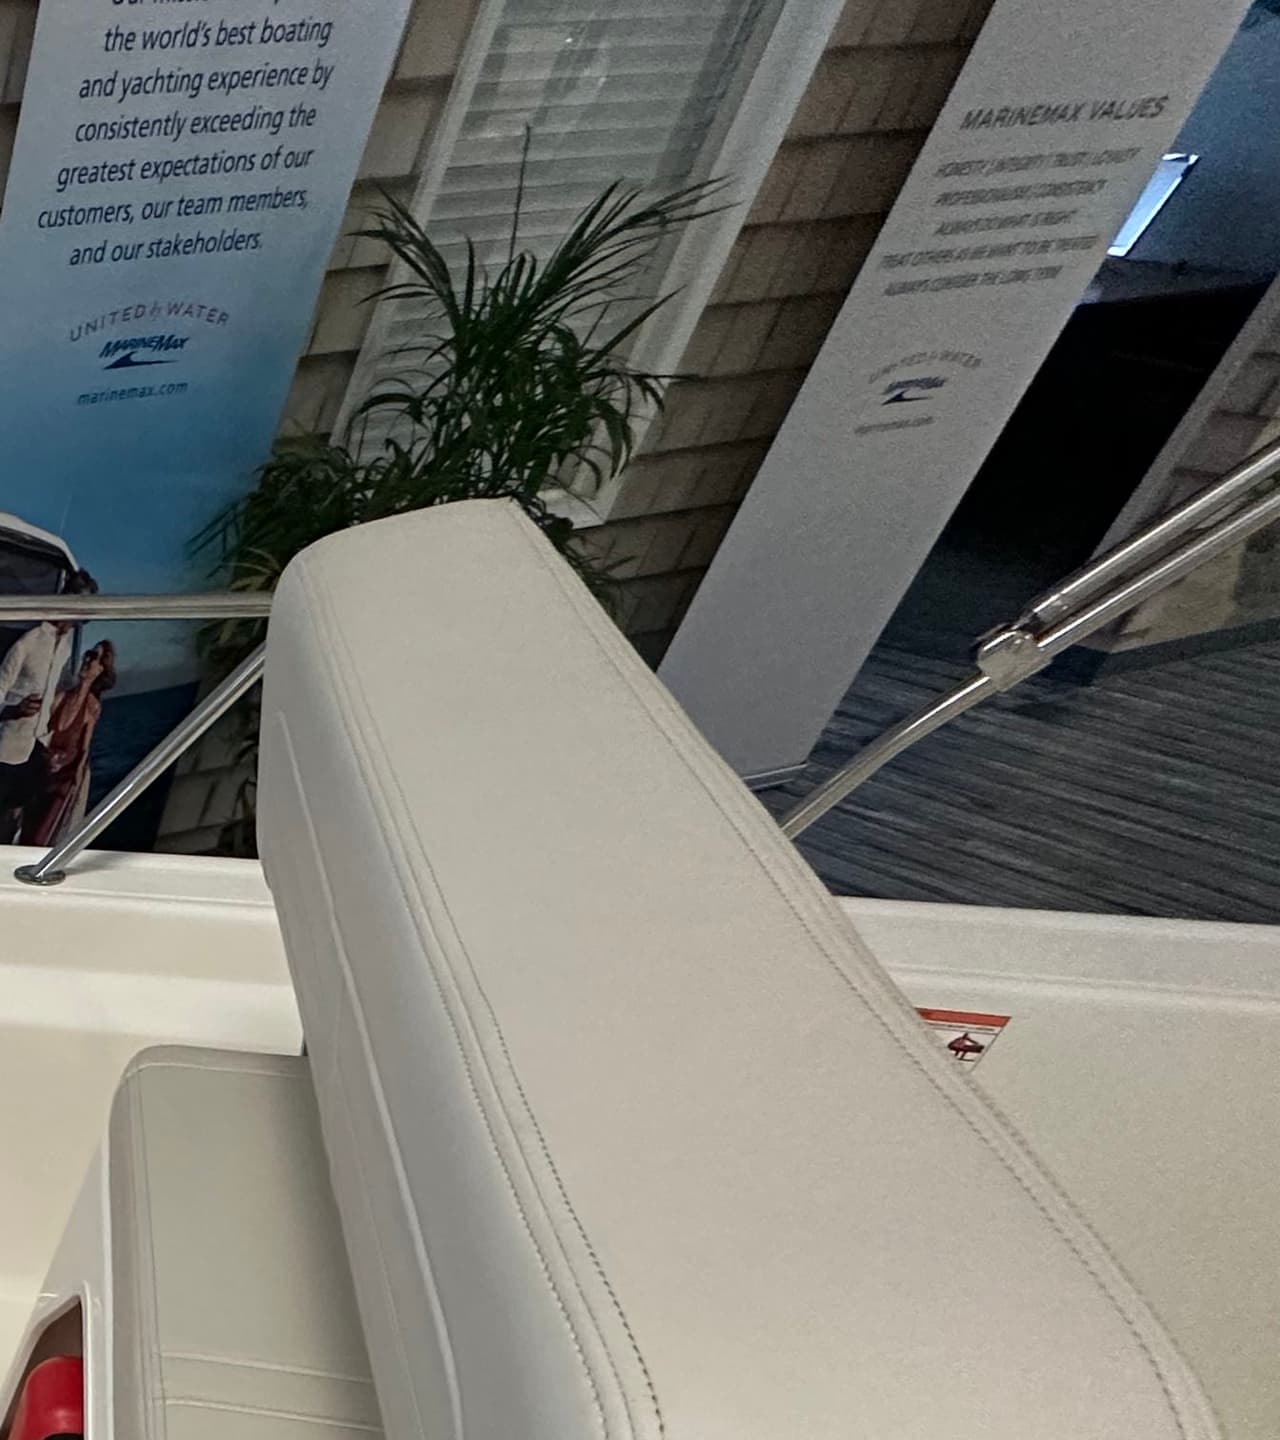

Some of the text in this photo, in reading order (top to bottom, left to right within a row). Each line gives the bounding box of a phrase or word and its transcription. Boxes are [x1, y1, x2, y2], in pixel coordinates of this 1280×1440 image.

[104, 16, 334, 52] the world's best boating
[79, 58, 335, 104] and yachting experience by
[75, 102, 317, 143] consistently exceeding the
[960, 95, 1169, 130] MARINEMAX VALUES
[56, 146, 315, 192] greatest expectations of our
[38, 187, 308, 230] customers, our team members,
[69, 229, 263, 267] and our stakeholders.
[69, 304, 145, 342] UNITED
[166, 301, 230, 328] WATER
[77, 381, 189, 405] marinemax.com
